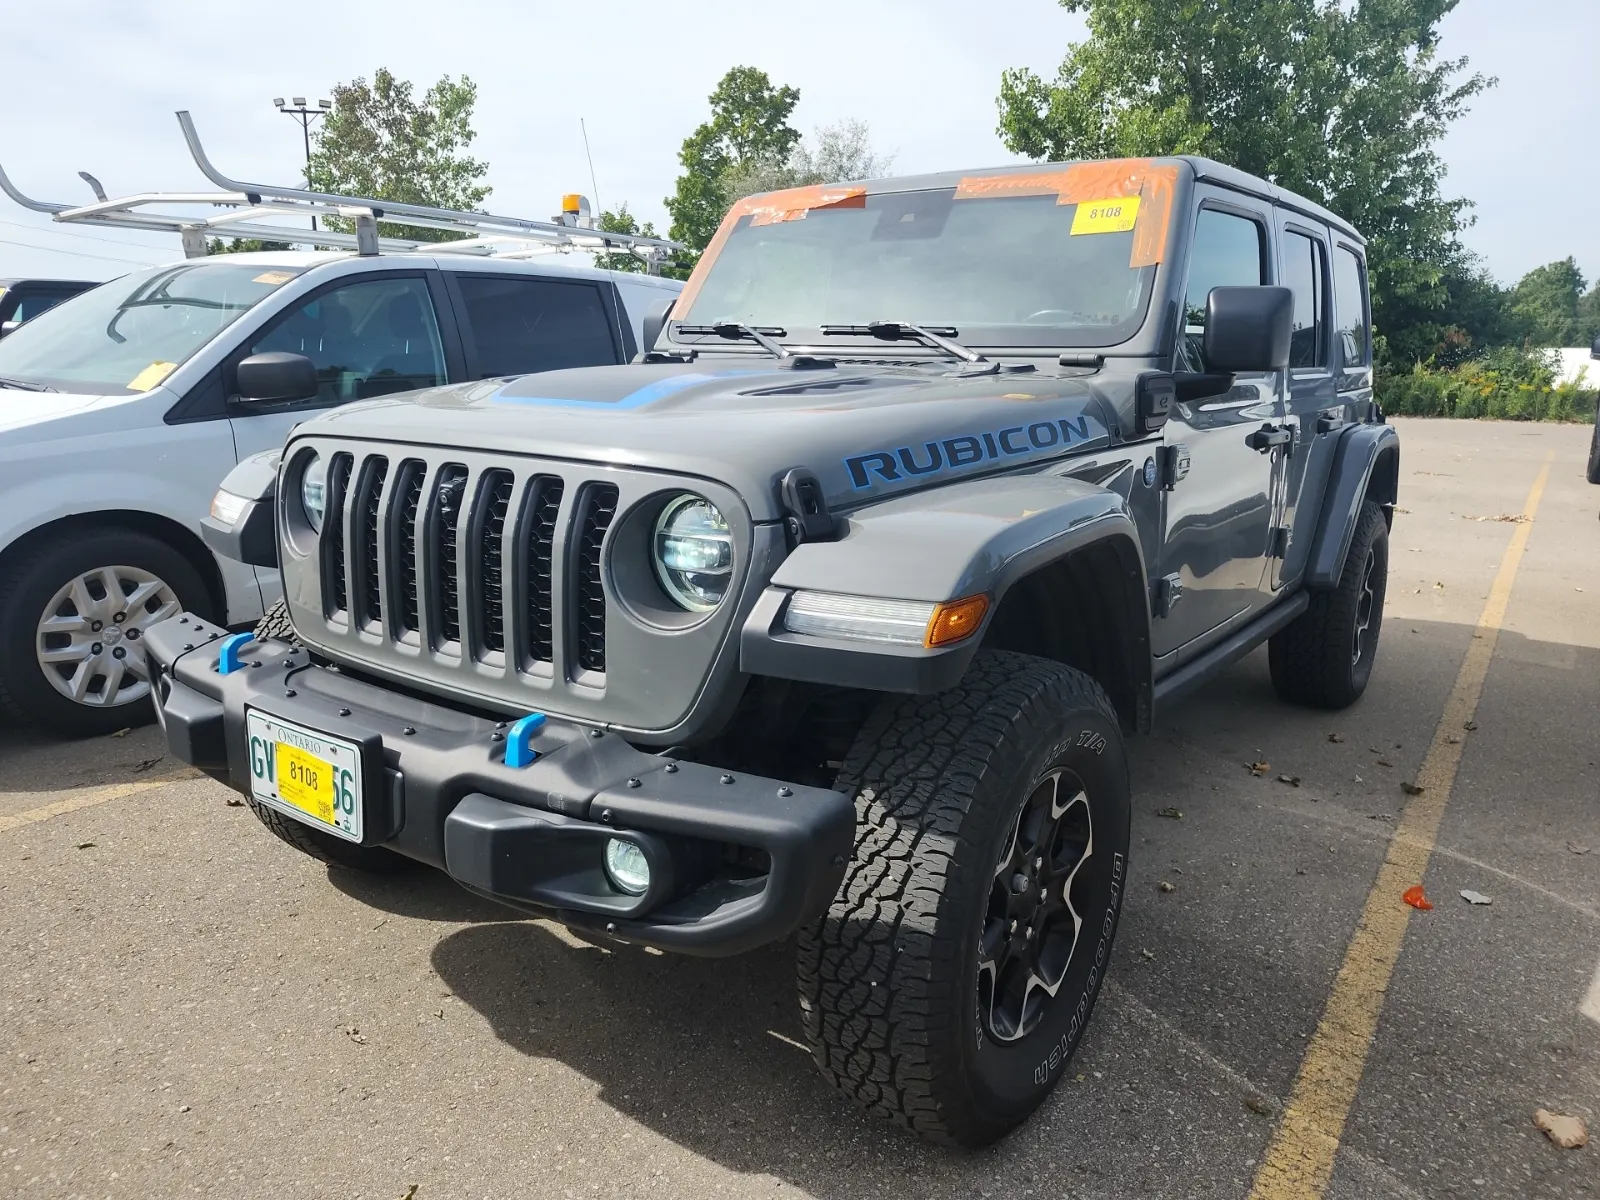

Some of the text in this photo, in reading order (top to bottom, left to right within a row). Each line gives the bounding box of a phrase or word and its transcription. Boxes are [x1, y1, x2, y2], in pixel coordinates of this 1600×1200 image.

[1090, 207, 1122, 219] 8108
[843, 414, 1091, 490] RUBICON
[278, 729, 321, 753] ONTARIO
[1076, 729, 1107, 755] T/A
[290, 761, 318, 791] 8108
